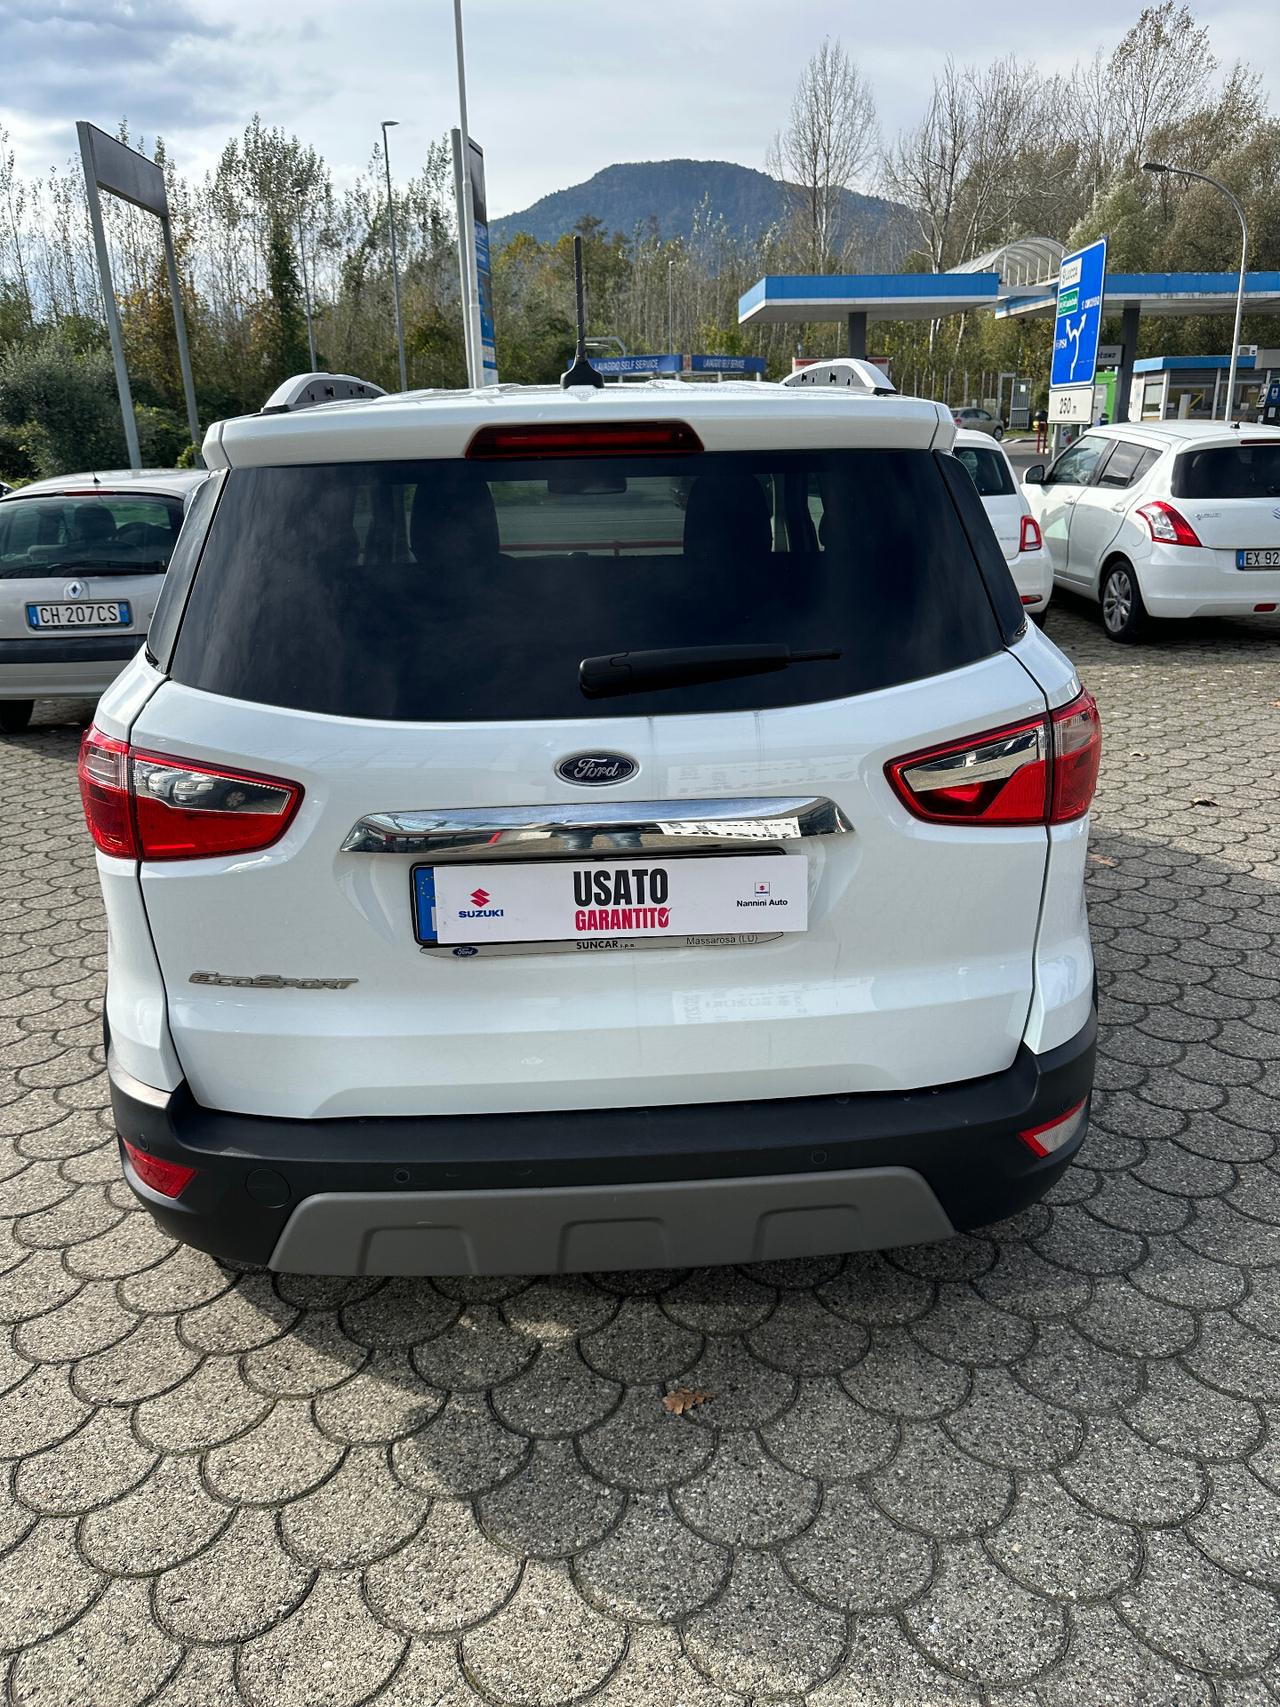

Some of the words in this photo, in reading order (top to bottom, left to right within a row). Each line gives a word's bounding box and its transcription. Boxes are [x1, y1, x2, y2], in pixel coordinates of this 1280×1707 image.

[620, 360, 634, 370] SELF
[635, 358, 659, 370] SERVICE
[1060, 397, 1071, 415] 250
[1246, 552, 1260, 565] EX
[1265, 552, 1279, 565] 92
[40, 607, 61, 624] CH
[65, 605, 118, 623] 207CS
[574, 758, 619, 777] Ford
[573, 868, 669, 907] USATO
[736, 899, 767, 907] Nannini
[458, 909, 504, 918] SUZUKI
[575, 907, 672, 932] GARANTITO
[576, 940, 619, 950] SUNCAR
[686, 935, 736, 945] Massarosa
